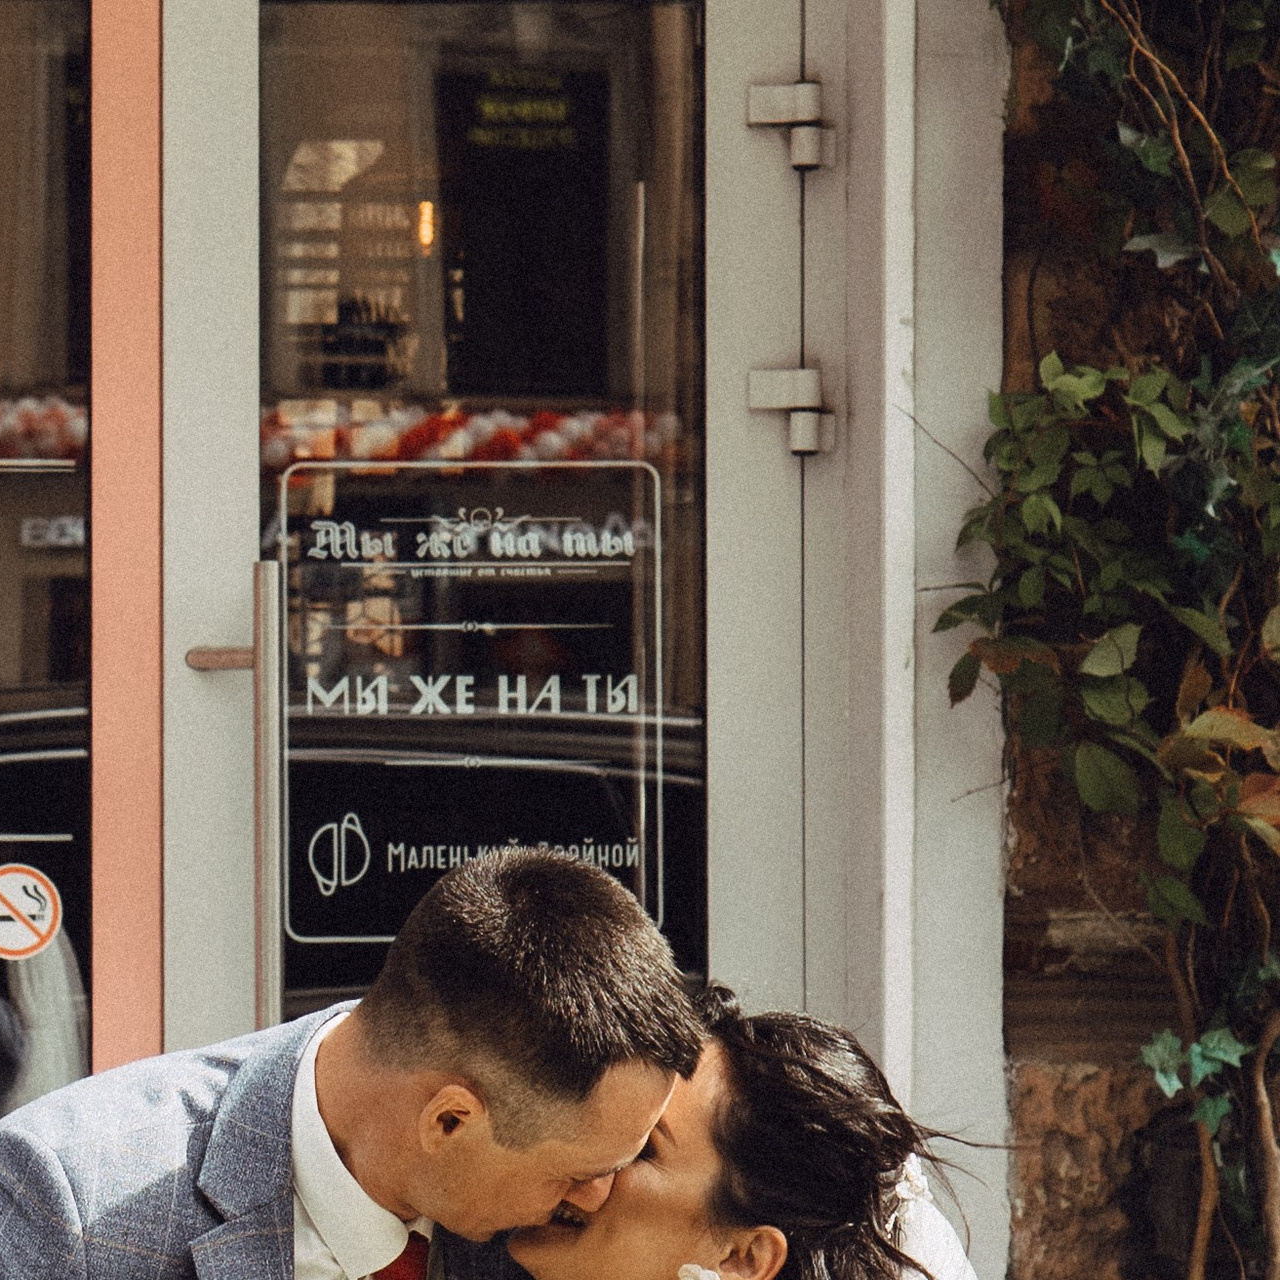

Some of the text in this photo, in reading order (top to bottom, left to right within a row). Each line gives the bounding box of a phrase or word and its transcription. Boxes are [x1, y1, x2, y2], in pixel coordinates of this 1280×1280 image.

[306, 673, 639, 716] МЫ ЖЕ НА ТЫ
